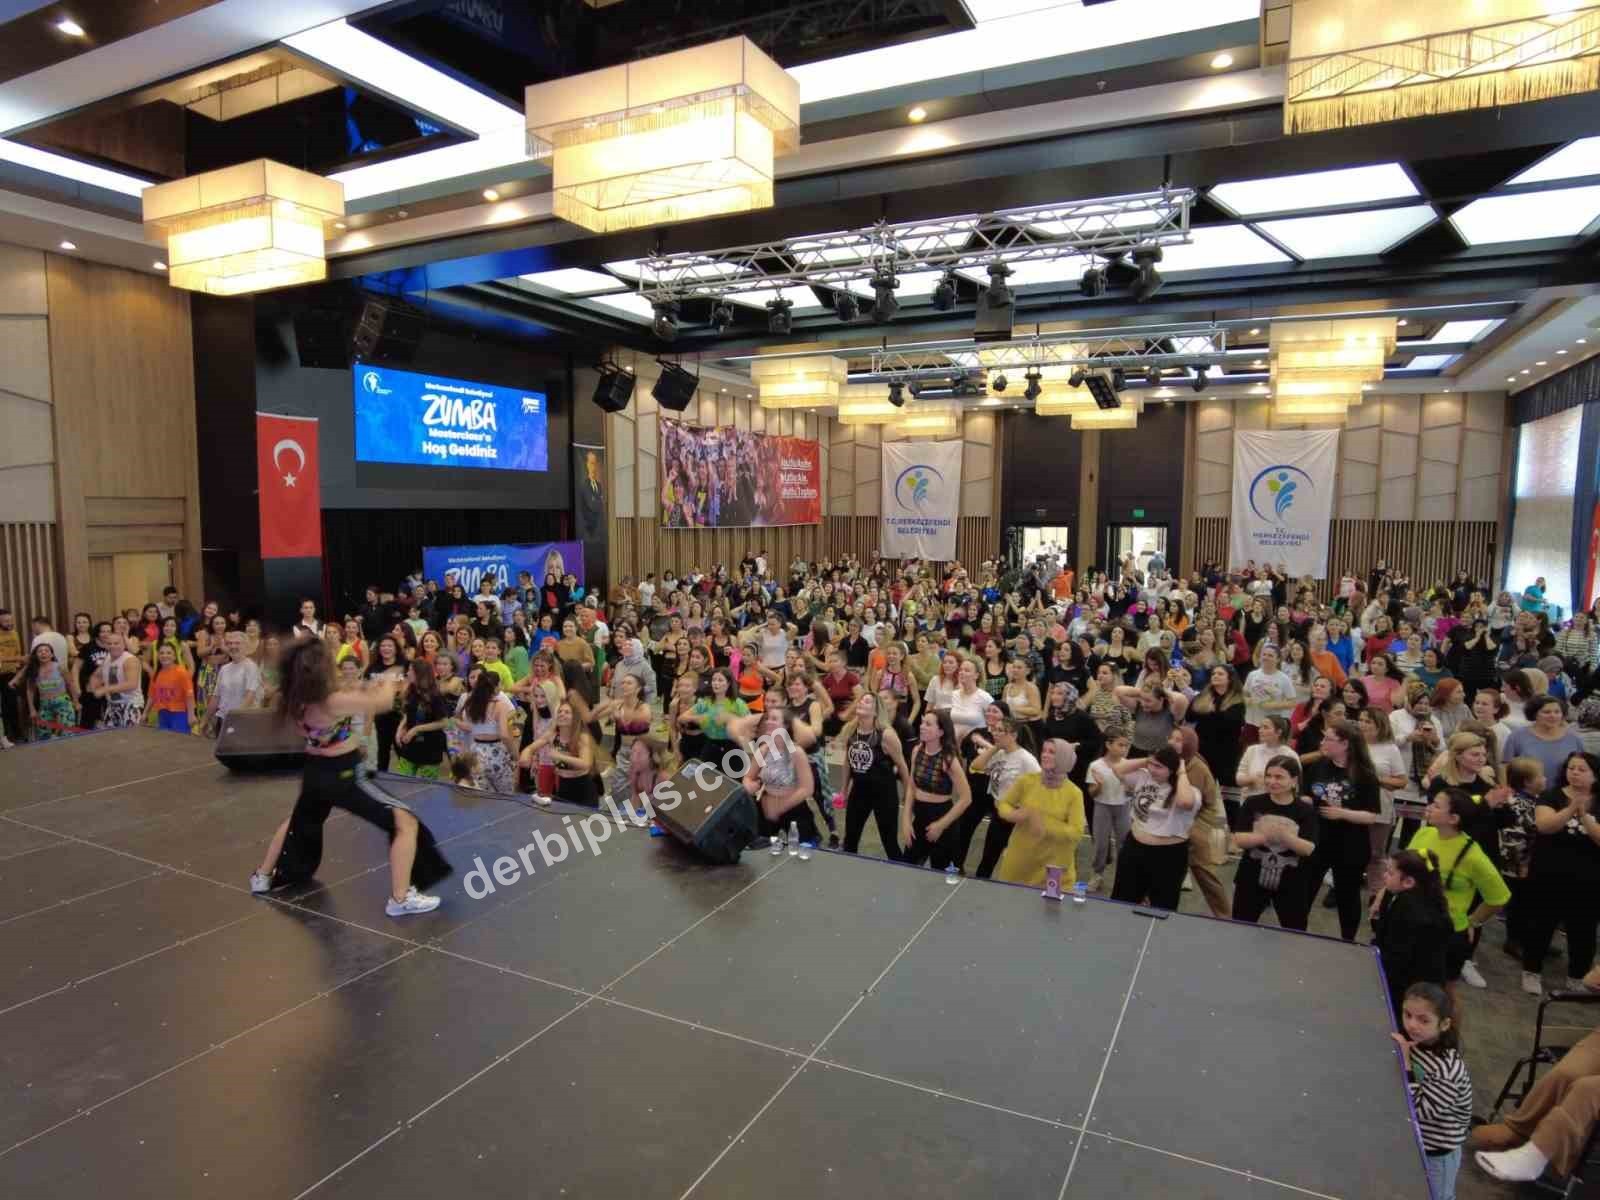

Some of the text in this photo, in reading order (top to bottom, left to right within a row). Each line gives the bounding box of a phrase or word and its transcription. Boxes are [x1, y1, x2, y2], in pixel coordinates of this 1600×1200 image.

[420, 394, 497, 431] ZUMBA
[422, 441, 498, 459] Hoş Geldiniz
